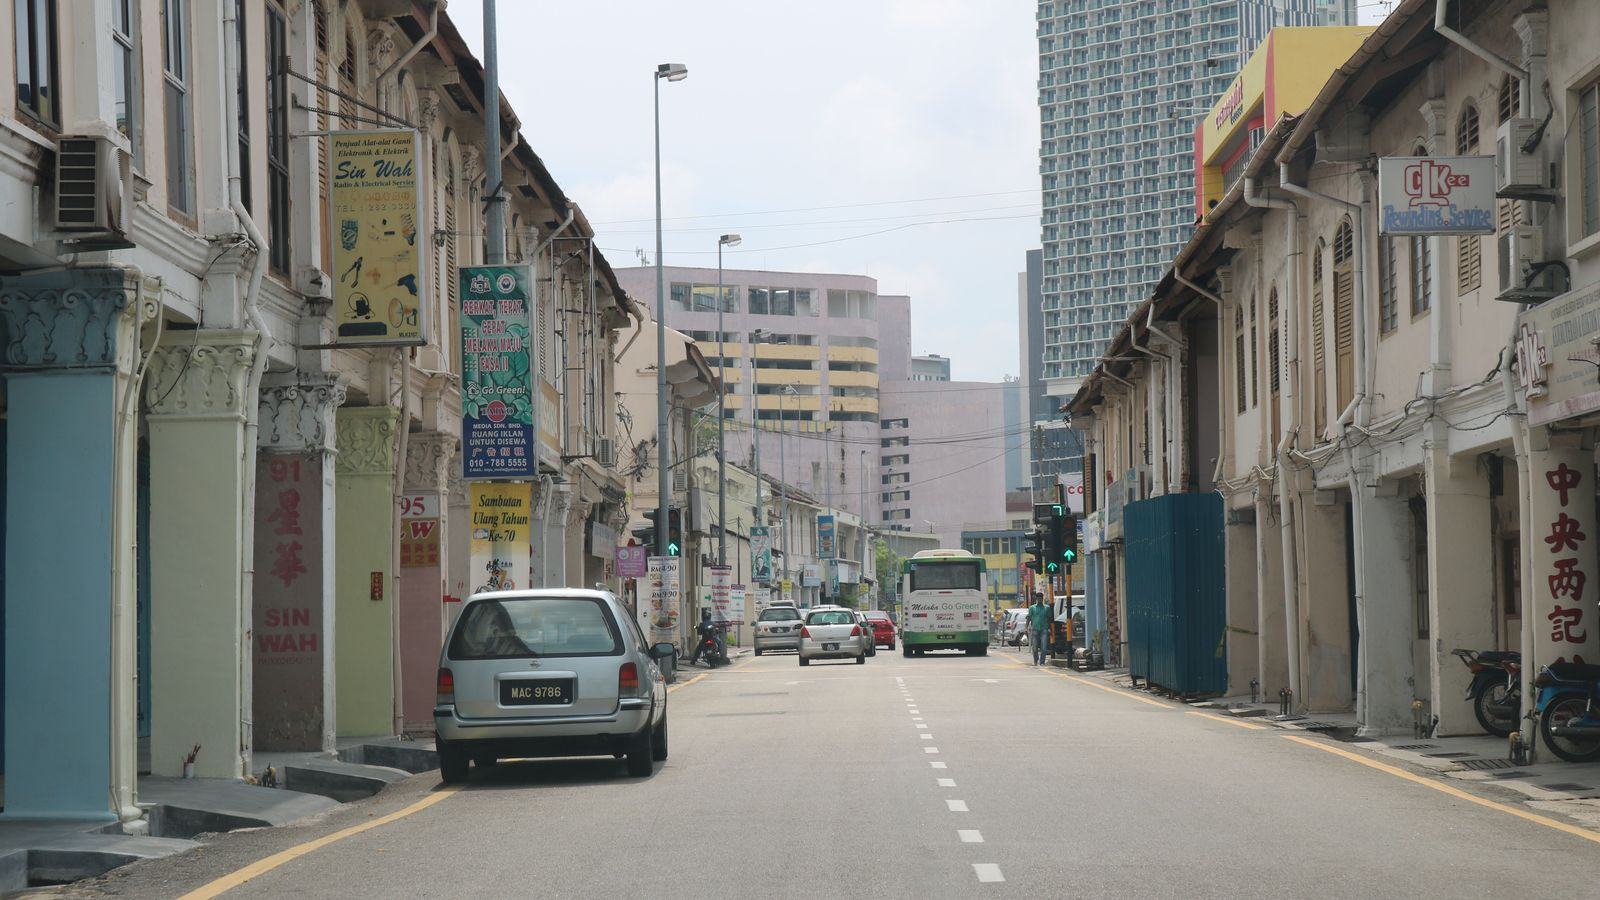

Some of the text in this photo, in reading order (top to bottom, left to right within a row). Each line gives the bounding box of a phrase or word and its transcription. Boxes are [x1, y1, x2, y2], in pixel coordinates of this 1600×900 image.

[335, 140, 360, 148] Penjual
[335, 160, 412, 179] Sin Wah
[1449, 203, 1492, 228] Service
[466, 337, 522, 352] MELAKA MAJU
[482, 385, 526, 394] Go Green!
[470, 459, 484, 467] 010
[490, 459, 505, 467] 788
[507, 458, 527, 466] 5555
[270, 459, 301, 483] 91
[400, 497, 425, 516] 95
[479, 495, 522, 507] Sambutan
[473, 512, 528, 527] Ulang Tahun
[488, 530, 515, 542] Ke-70
[911, 602, 979, 611] Melaka Go Green
[264, 608, 310, 628] SIN
[257, 634, 317, 653] WAH
[511, 686, 561, 698] MAC 9786
